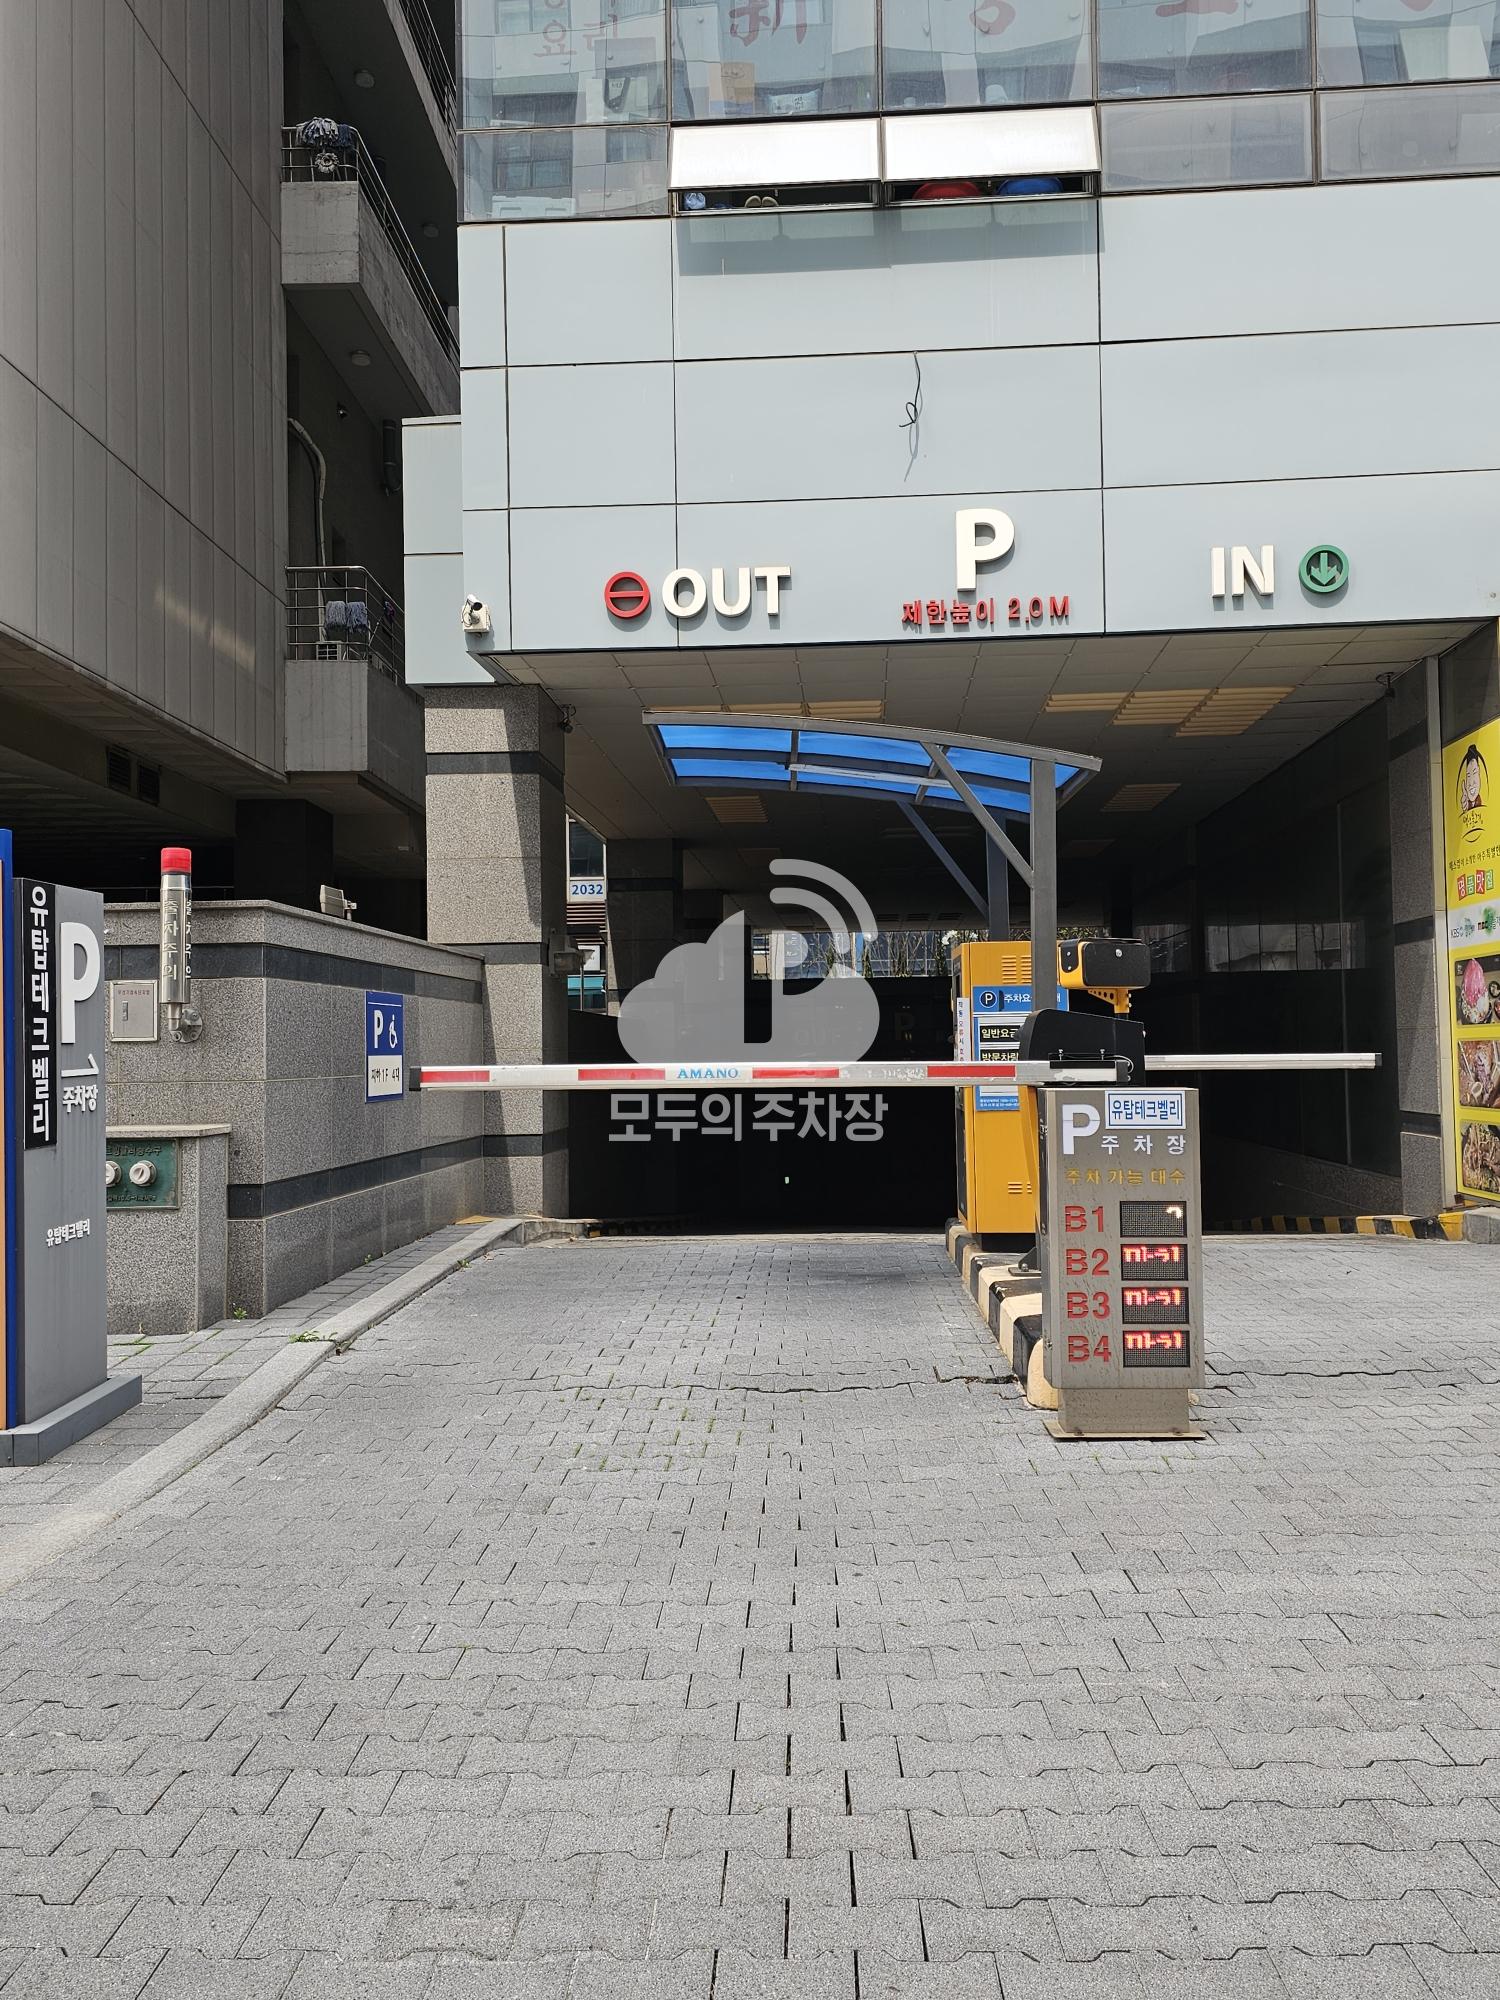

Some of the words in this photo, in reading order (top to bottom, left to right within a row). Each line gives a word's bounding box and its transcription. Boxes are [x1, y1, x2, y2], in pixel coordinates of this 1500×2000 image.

[956, 508, 1015, 592] P
[1211, 544, 1275, 598] IN
[662, 566, 792, 617] OUT
[902, 598, 995, 625] 제한높이
[1008, 595, 1070, 624] 2.0M
[572, 884, 604, 895] 2032
[61, 921, 100, 1044] P
[30, 886, 50, 1141] 유탑테크벨리
[374, 1009, 384, 1049] P
[677, 1068, 740, 1080] AMANO
[63, 1084, 98, 1113] 주차장
[1111, 1099, 1180, 1120] 유탑테크벨리
[1062, 1103, 1101, 1155] P
[1066, 1168, 1100, 1185] 주차
[1108, 1168, 1144, 1185] 가능
[1151, 1168, 1186, 1185] 대수
[1065, 1205, 1104, 1233] B1
[1066, 1248, 1110, 1276] B2
[1067, 1291, 1111, 1319] B3
[1068, 1335, 1112, 1363] B4
